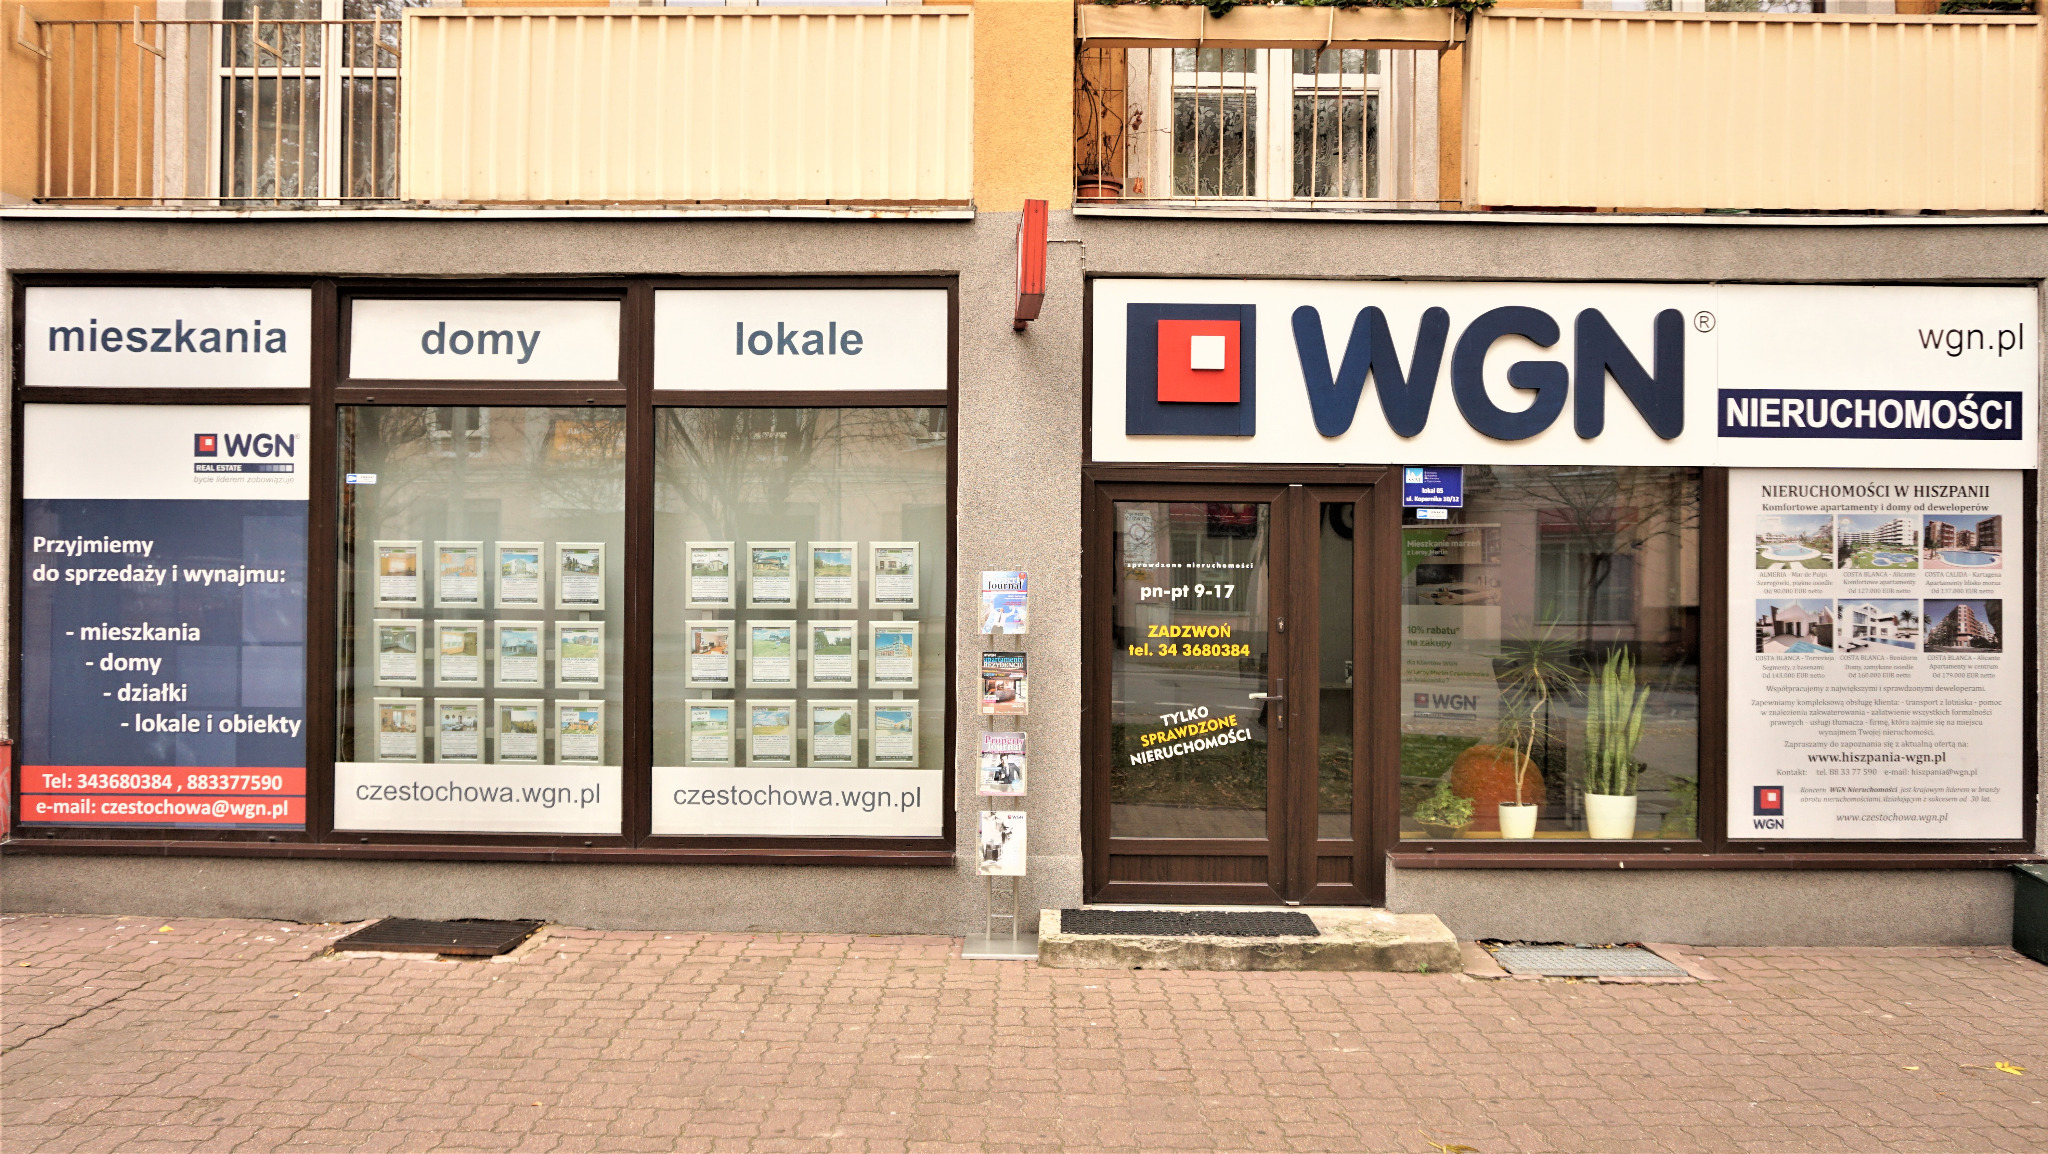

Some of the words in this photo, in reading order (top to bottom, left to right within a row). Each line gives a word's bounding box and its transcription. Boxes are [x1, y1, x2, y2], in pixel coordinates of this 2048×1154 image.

[48, 319, 287, 354] mieszkania
[421, 322, 541, 365] domy
[735, 322, 865, 357] lokale
[1918, 323, 2024, 357] wgn.pl
[1291, 305, 1684, 441] WGN
[1726, 393, 2012, 430] NIERUCHOMOŚCI
[224, 433, 294, 457] WGN
[193, 475, 214, 484] bycie
[216, 475, 244, 483] liderem
[247, 475, 294, 484] zobowiązuje
[1762, 482, 1890, 498] NIERUCHOMOŚCI
[1894, 485, 1909, 498] W
[1913, 485, 1990, 498] HISZPANII
[1762, 503, 1818, 512] Komfortowe
[1820, 504, 1878, 513] apartamenty
[1880, 503, 1884, 511] i
[1886, 503, 1912, 513] domy
[1914, 503, 1925, 512] od
[1928, 503, 1989, 513] deweloperów
[32, 535, 154, 558] Przyjmiemy
[1127, 561, 1182, 570] sprawdzone
[1187, 561, 1254, 569] nieruchomości
[33, 564, 60, 584] do
[64, 564, 166, 588] sprzedaży
[170, 564, 177, 584] i
[183, 564, 286, 588] wynajmu:
[1140, 584, 1190, 601] pn-pt
[1194, 584, 1235, 599] 9-17
[80, 622, 200, 642] mieszkania
[1148, 623, 1231, 638] ZADZWOŃ
[1407, 626, 1424, 634] 10%
[1129, 644, 1153, 657] tel.
[1158, 644, 1177, 656] 34
[1182, 644, 1250, 657] 3680384
[1420, 639, 1452, 648] zakupy
[99, 652, 162, 675] domy
[117, 683, 187, 703] działki
[1766, 685, 1823, 694] Współpracujemy
[1831, 685, 1877, 693] największymi
[1883, 685, 1934, 693] sprawdzonymi
[1935, 685, 1986, 693] deweloperami.
[1432, 693, 1477, 710] WGN
[1751, 699, 1795, 707] Zapewniamy
[1797, 699, 1844, 707] kompleksową
[1846, 699, 1873, 707] obsługę
[1906, 699, 1938, 707] transport
[1160, 706, 1209, 727] TYLKO
[1912, 709, 1950, 717] wszystkich
[135, 714, 201, 733] lokale
[206, 714, 213, 733] i
[218, 714, 301, 738] obiekty
[1140, 714, 1238, 748] SPRAWDZONE
[1770, 719, 1804, 728] prawnych
[1810, 719, 1831, 727] usługi
[1869, 719, 1890, 727] firmę,
[1911, 719, 1933, 727] zajmie
[1935, 719, 1945, 727] się
[1956, 719, 1983, 727] miejscu
[1818, 729, 1857, 737] wynajmem
[1858, 729, 1881, 737] Twojej
[1130, 727, 1252, 766] NIERUCHOMOŚCI
[1784, 741, 1828, 749] Zapraszamy
[1840, 741, 1881, 749] zapoznania
[1901, 740, 1932, 748] aktualną
[1934, 740, 1956, 748] ofertą
[1808, 752, 1946, 765] www.hiszpania-wgn.pl
[1776, 768, 1808, 776] Kontakt:
[1911, 768, 1978, 777] hiszpania@wgn.pl
[42, 773, 73, 790] Tel:
[77, 773, 172, 790] 343680384
[186, 773, 283, 790] 883377590
[1900, 786, 1912, 794] jest
[1913, 786, 1944, 794] krajowym
[1978, 786, 2000, 794] branży
[356, 781, 602, 808] czestochowa.wgn.pl
[673, 785, 922, 812] czestochowa.wgn.pl
[36, 798, 97, 816] e-mail:
[101, 798, 289, 819] czestochowa@wgn.pl
[1753, 819, 1784, 830] WGN
[1837, 813, 1948, 823] www.czestochowa.wgn.pl
